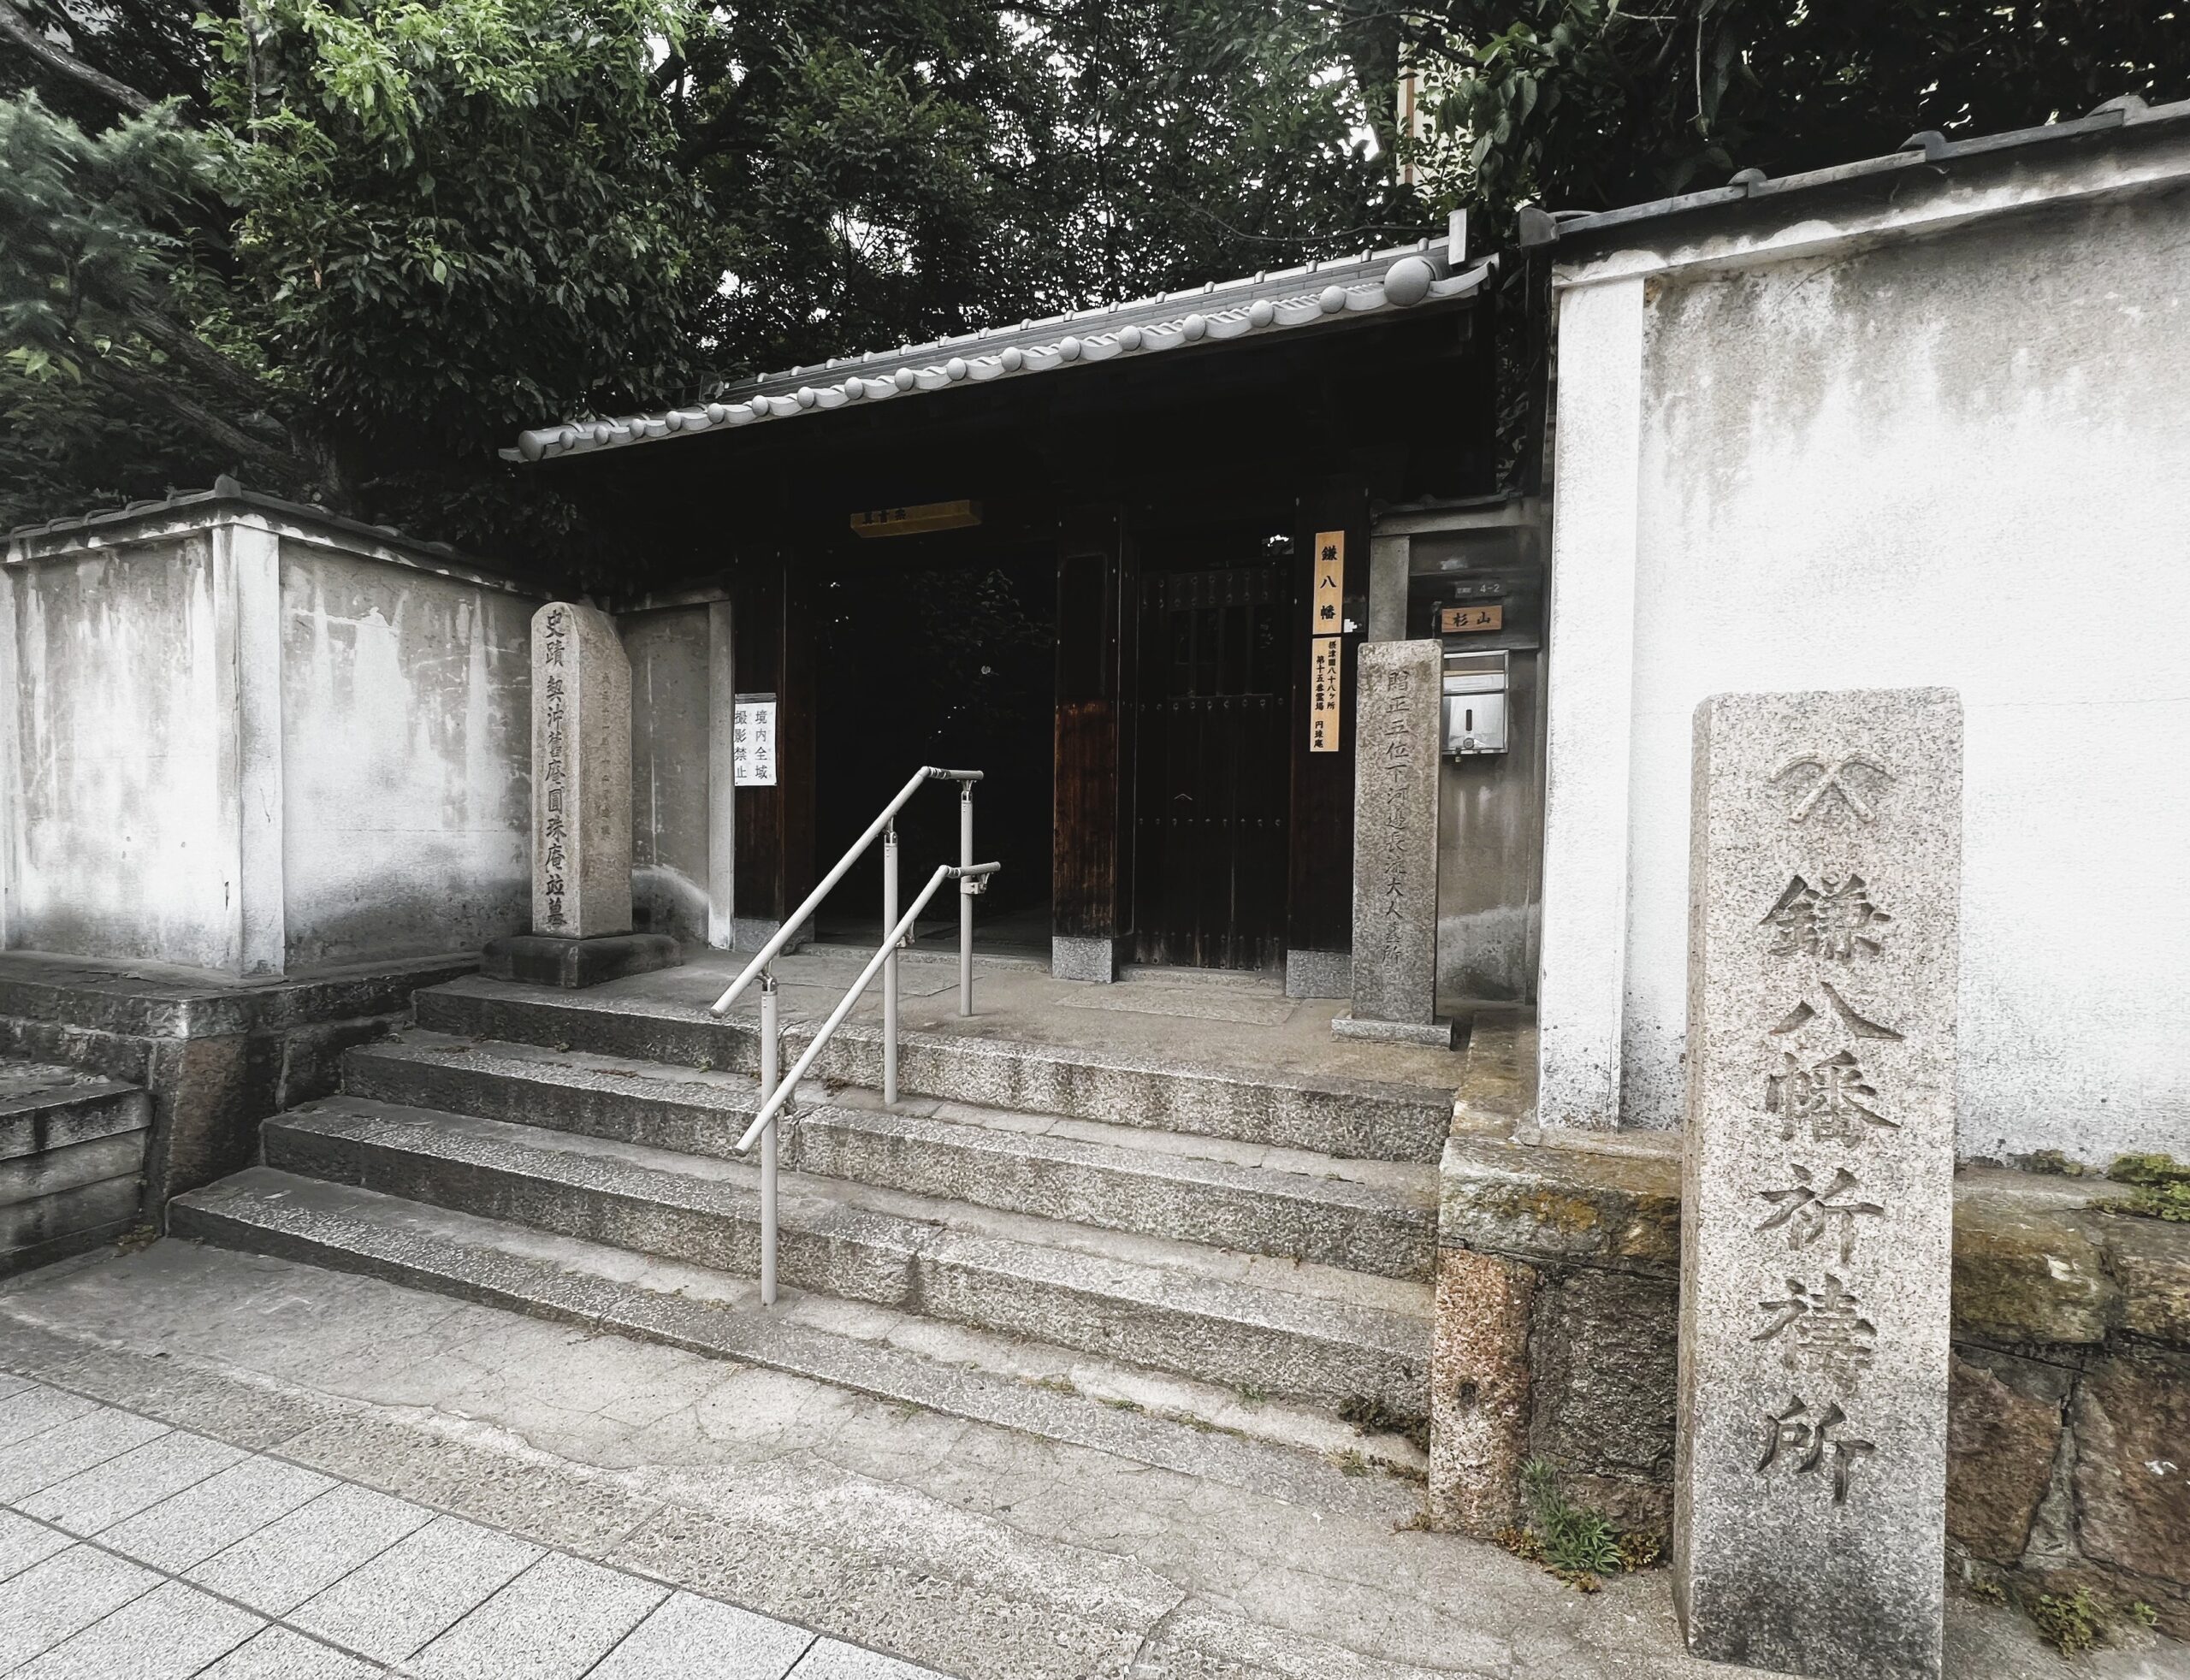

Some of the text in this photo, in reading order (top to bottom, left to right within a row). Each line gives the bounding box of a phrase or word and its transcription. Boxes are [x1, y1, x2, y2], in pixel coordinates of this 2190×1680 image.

[1320, 546, 1338, 620] 鎌八幡
[1480, 583, 1500, 593] 4-2
[1453, 612, 1491, 627] 杉山
[734, 710, 748, 778] 撮影禁止
[755, 709, 768, 779] 境内全域
[1313, 720, 1324, 748] 円珠庵
